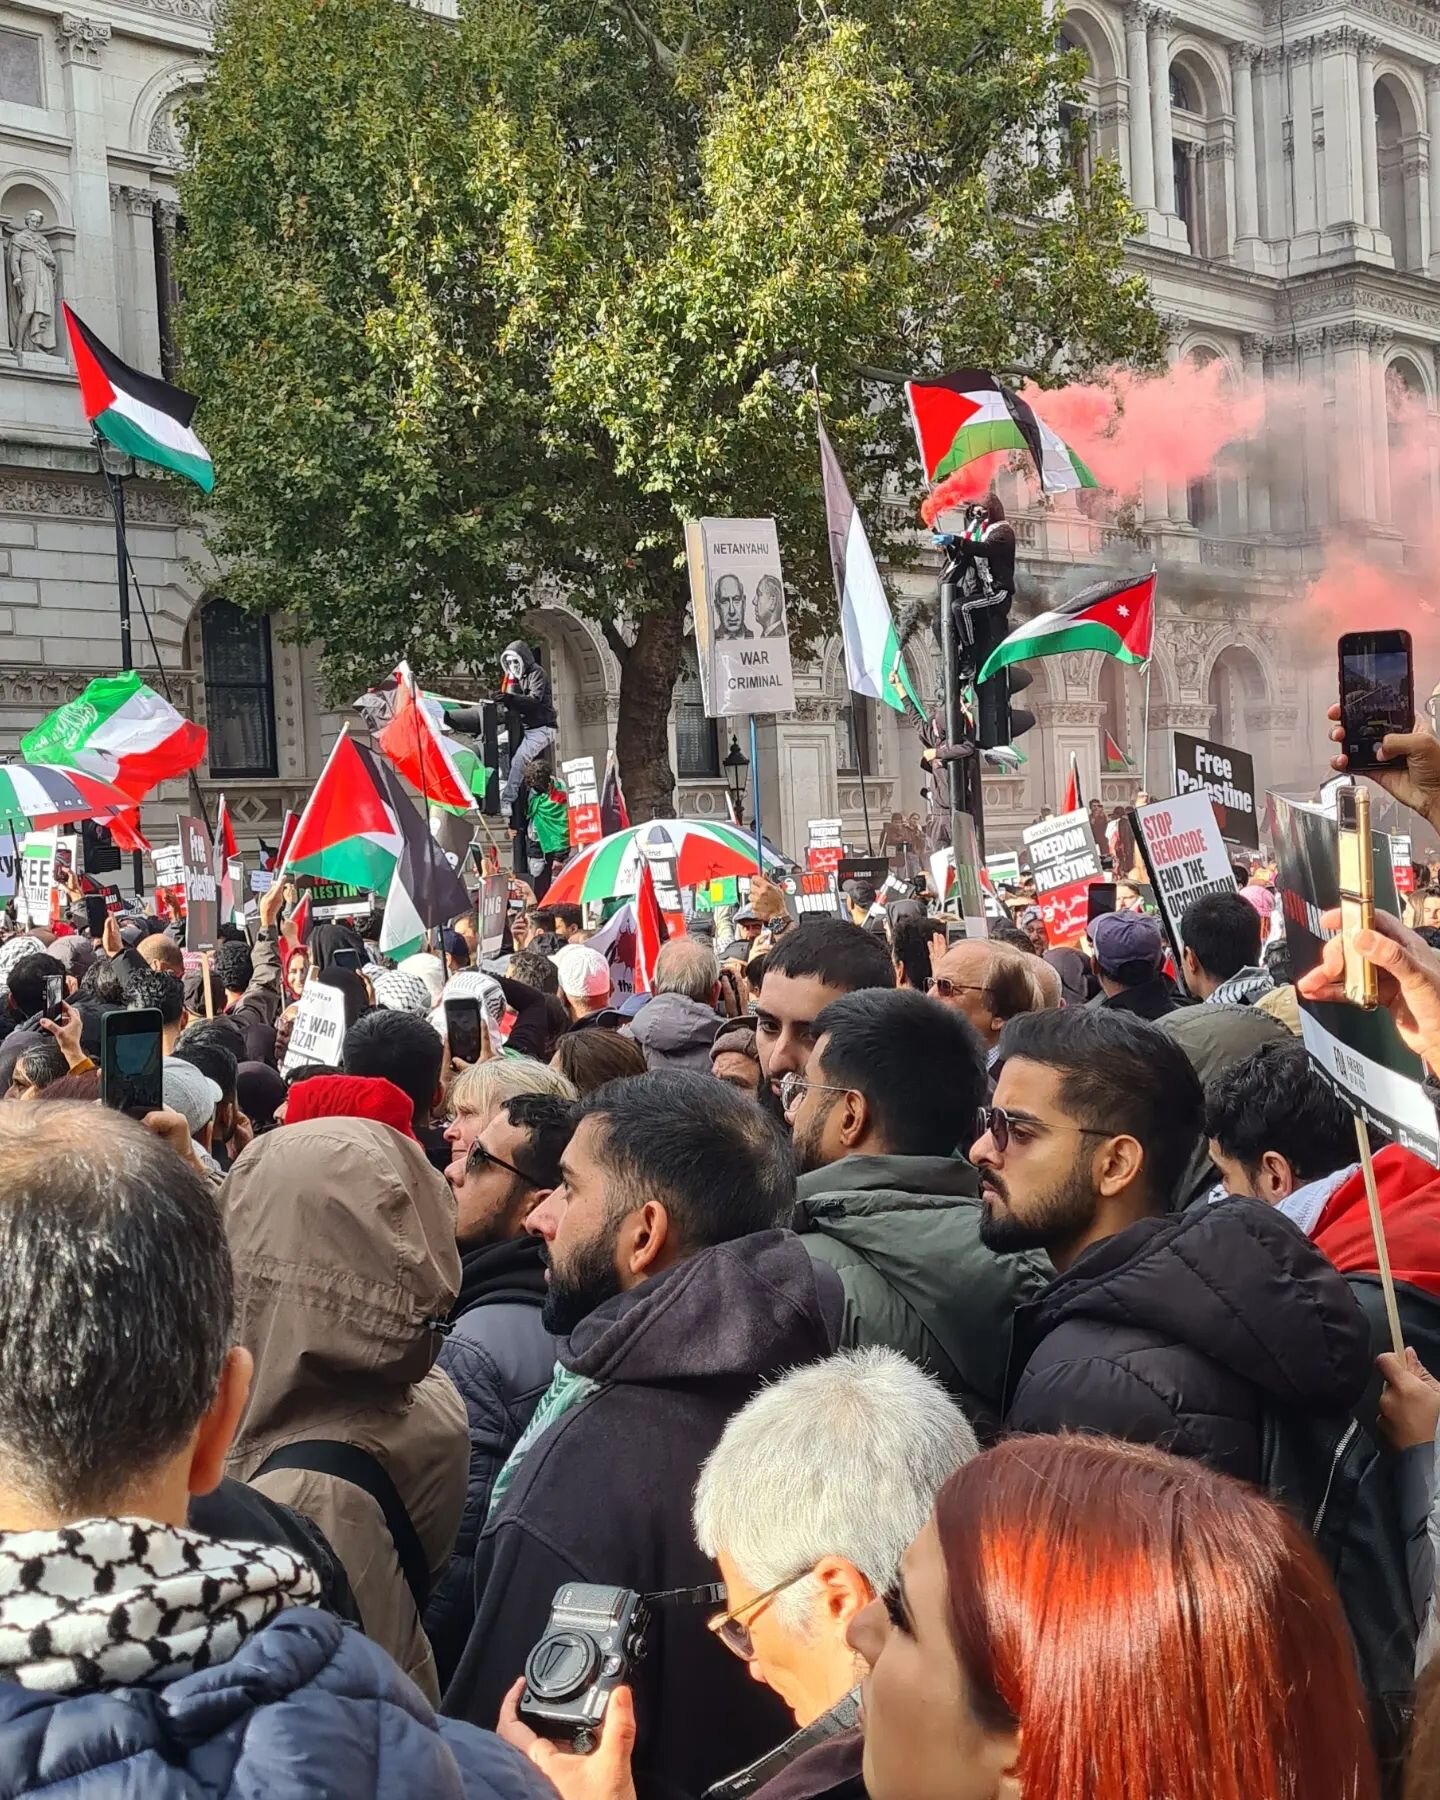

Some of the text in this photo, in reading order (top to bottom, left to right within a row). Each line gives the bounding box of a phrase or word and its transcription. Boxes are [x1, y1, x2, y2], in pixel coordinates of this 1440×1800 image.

[713, 543, 769, 555] NETANYAHU
[740, 650, 769, 666] WAR
[728, 675, 783, 690] CRIMINAL
[1195, 745, 1233, 780] Free
[1177, 768, 1253, 814] Palestine
[1143, 811, 1173, 841] STOP
[1029, 826, 1087, 864] FREEDOM
[1150, 828, 1208, 866] GENOCIDE
[801, 874, 826, 894] STOP
[1034, 854, 1098, 892] PALESTINE
[1158, 858, 1208, 894] END THE
[309, 1015, 337, 1039] WAR
